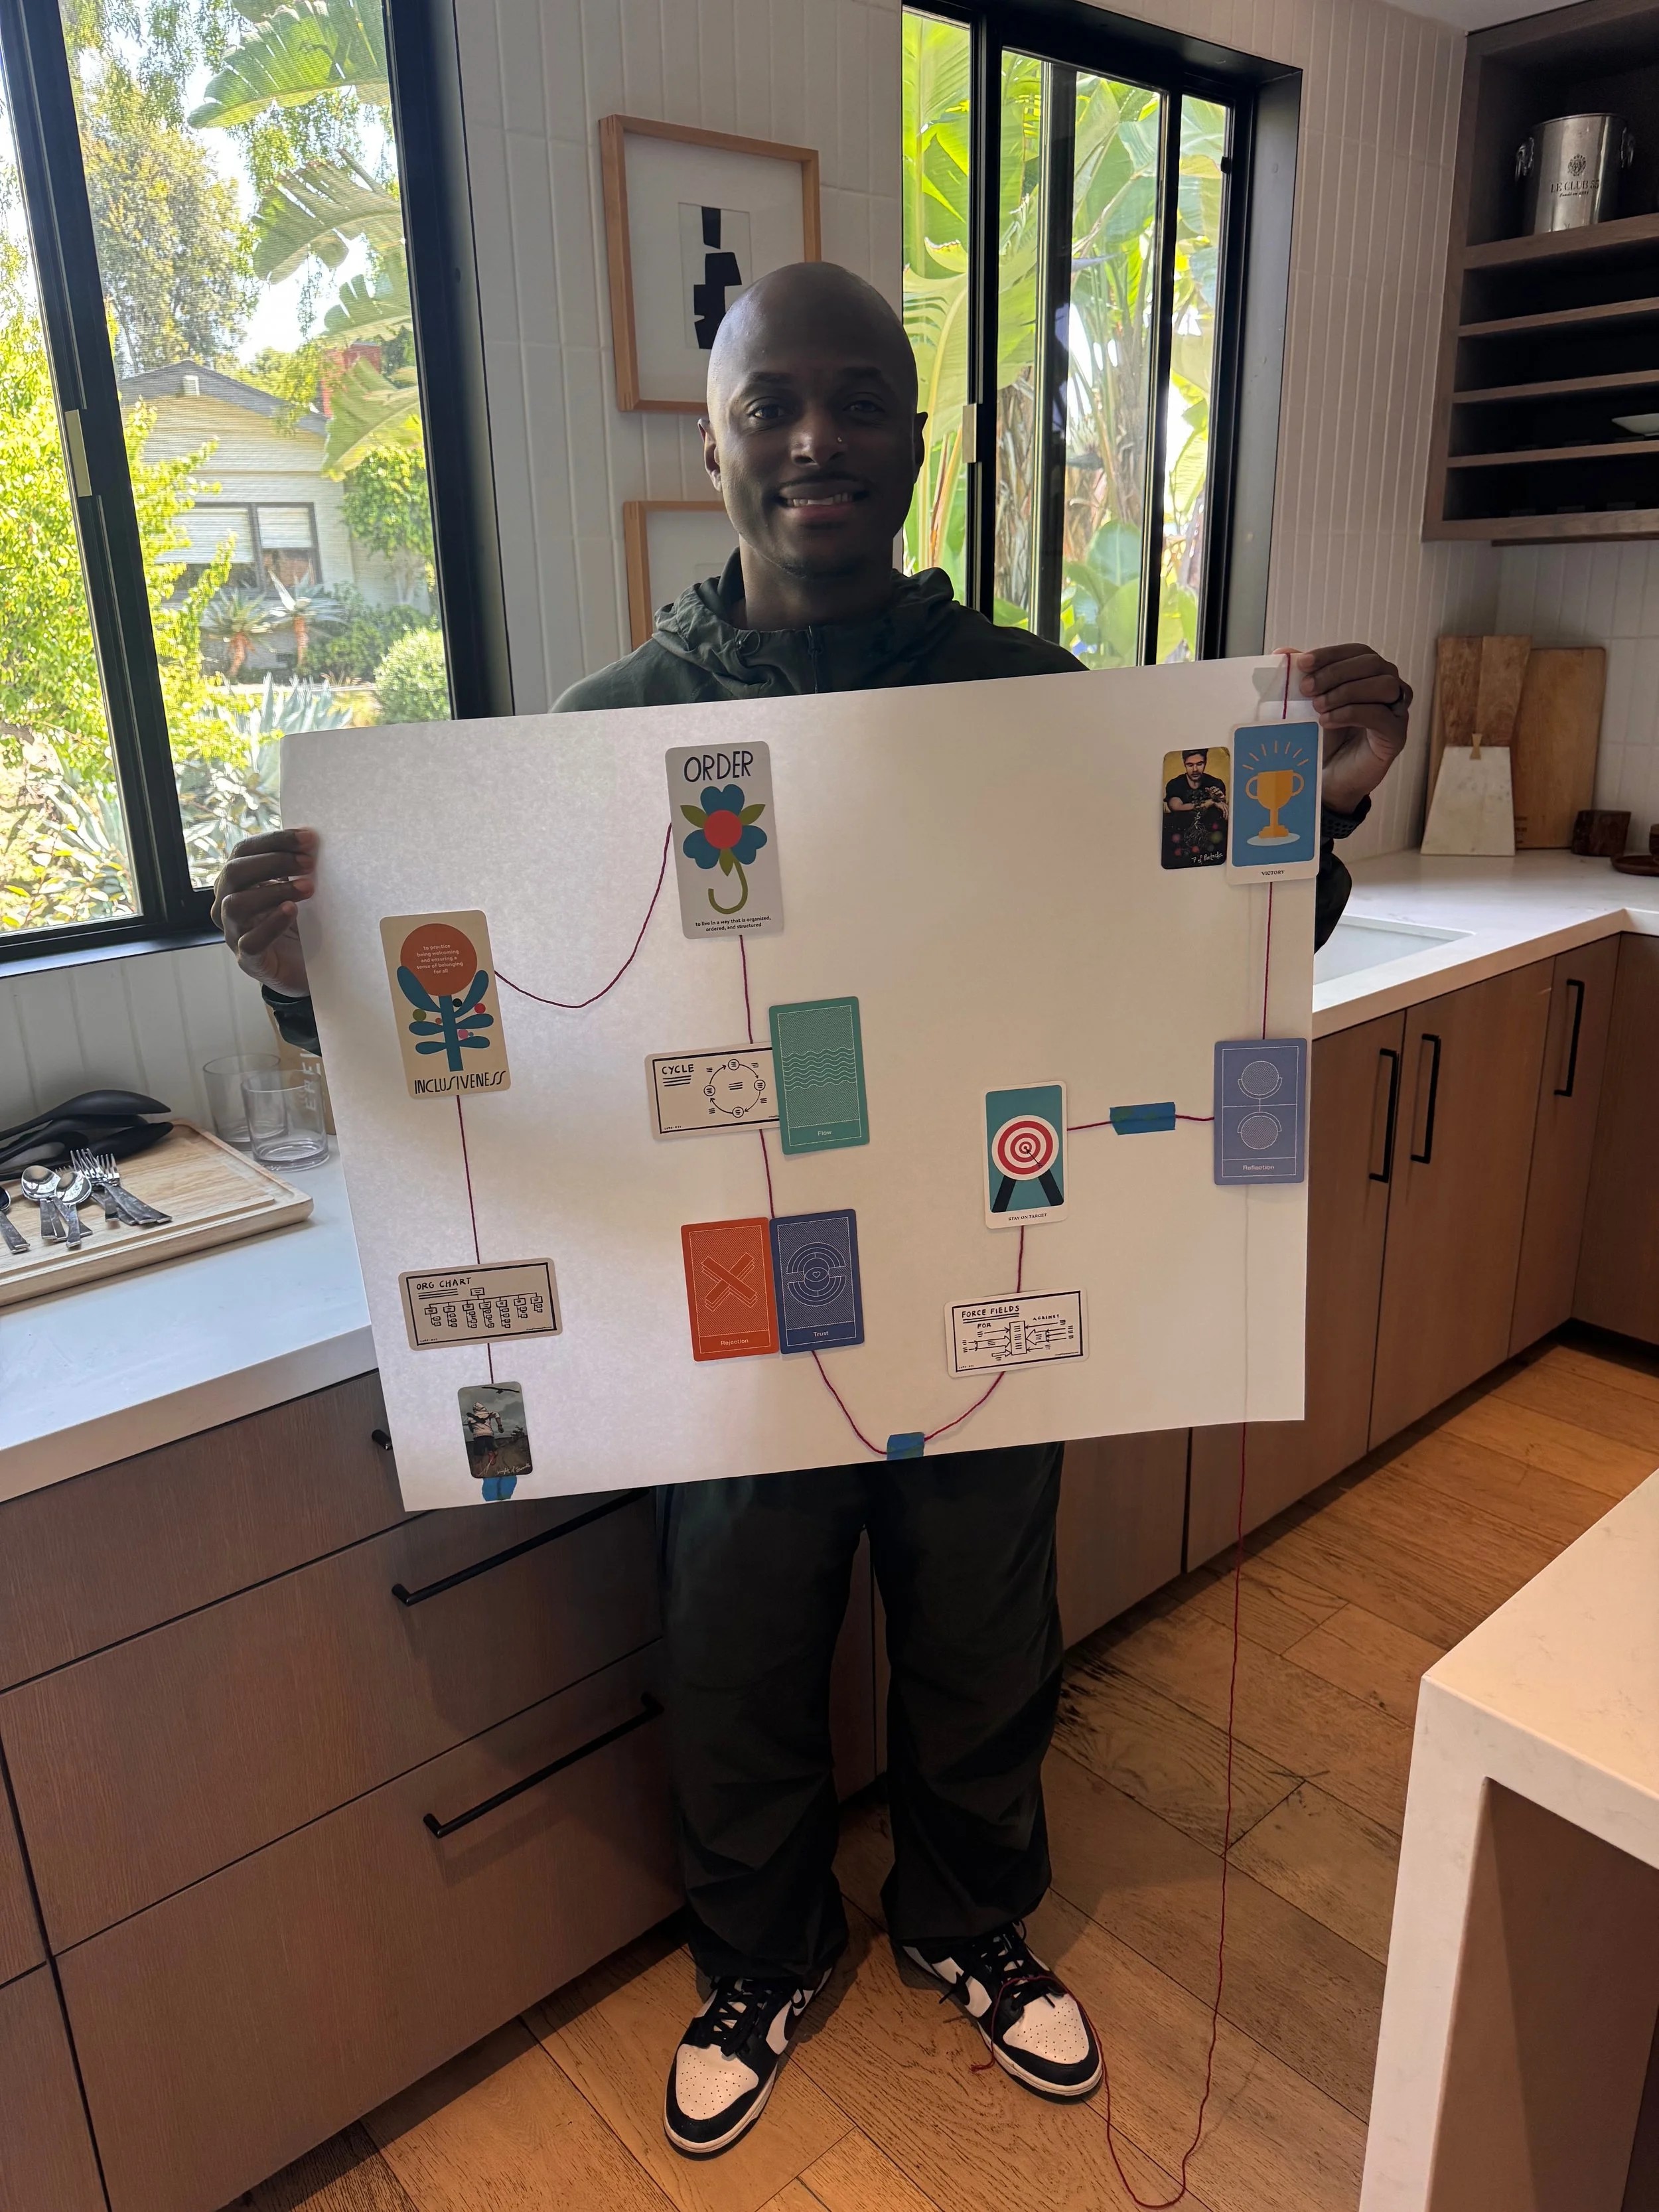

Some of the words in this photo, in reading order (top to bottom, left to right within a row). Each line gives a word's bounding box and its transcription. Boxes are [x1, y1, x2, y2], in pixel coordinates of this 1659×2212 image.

[1551, 183, 1562, 193] LE
[1564, 180, 1589, 190] CLUB
[684, 750, 754, 782] ORDER
[662, 1063, 695, 1075] CYCLE
[414, 1070, 506, 1094] INCLUSIVENESS
[416, 1282, 435, 1290] ORG
[439, 1277, 472, 1288] CHART
[962, 1309, 986, 1318] FORCE
[990, 1305, 1020, 1314] FIELDS
